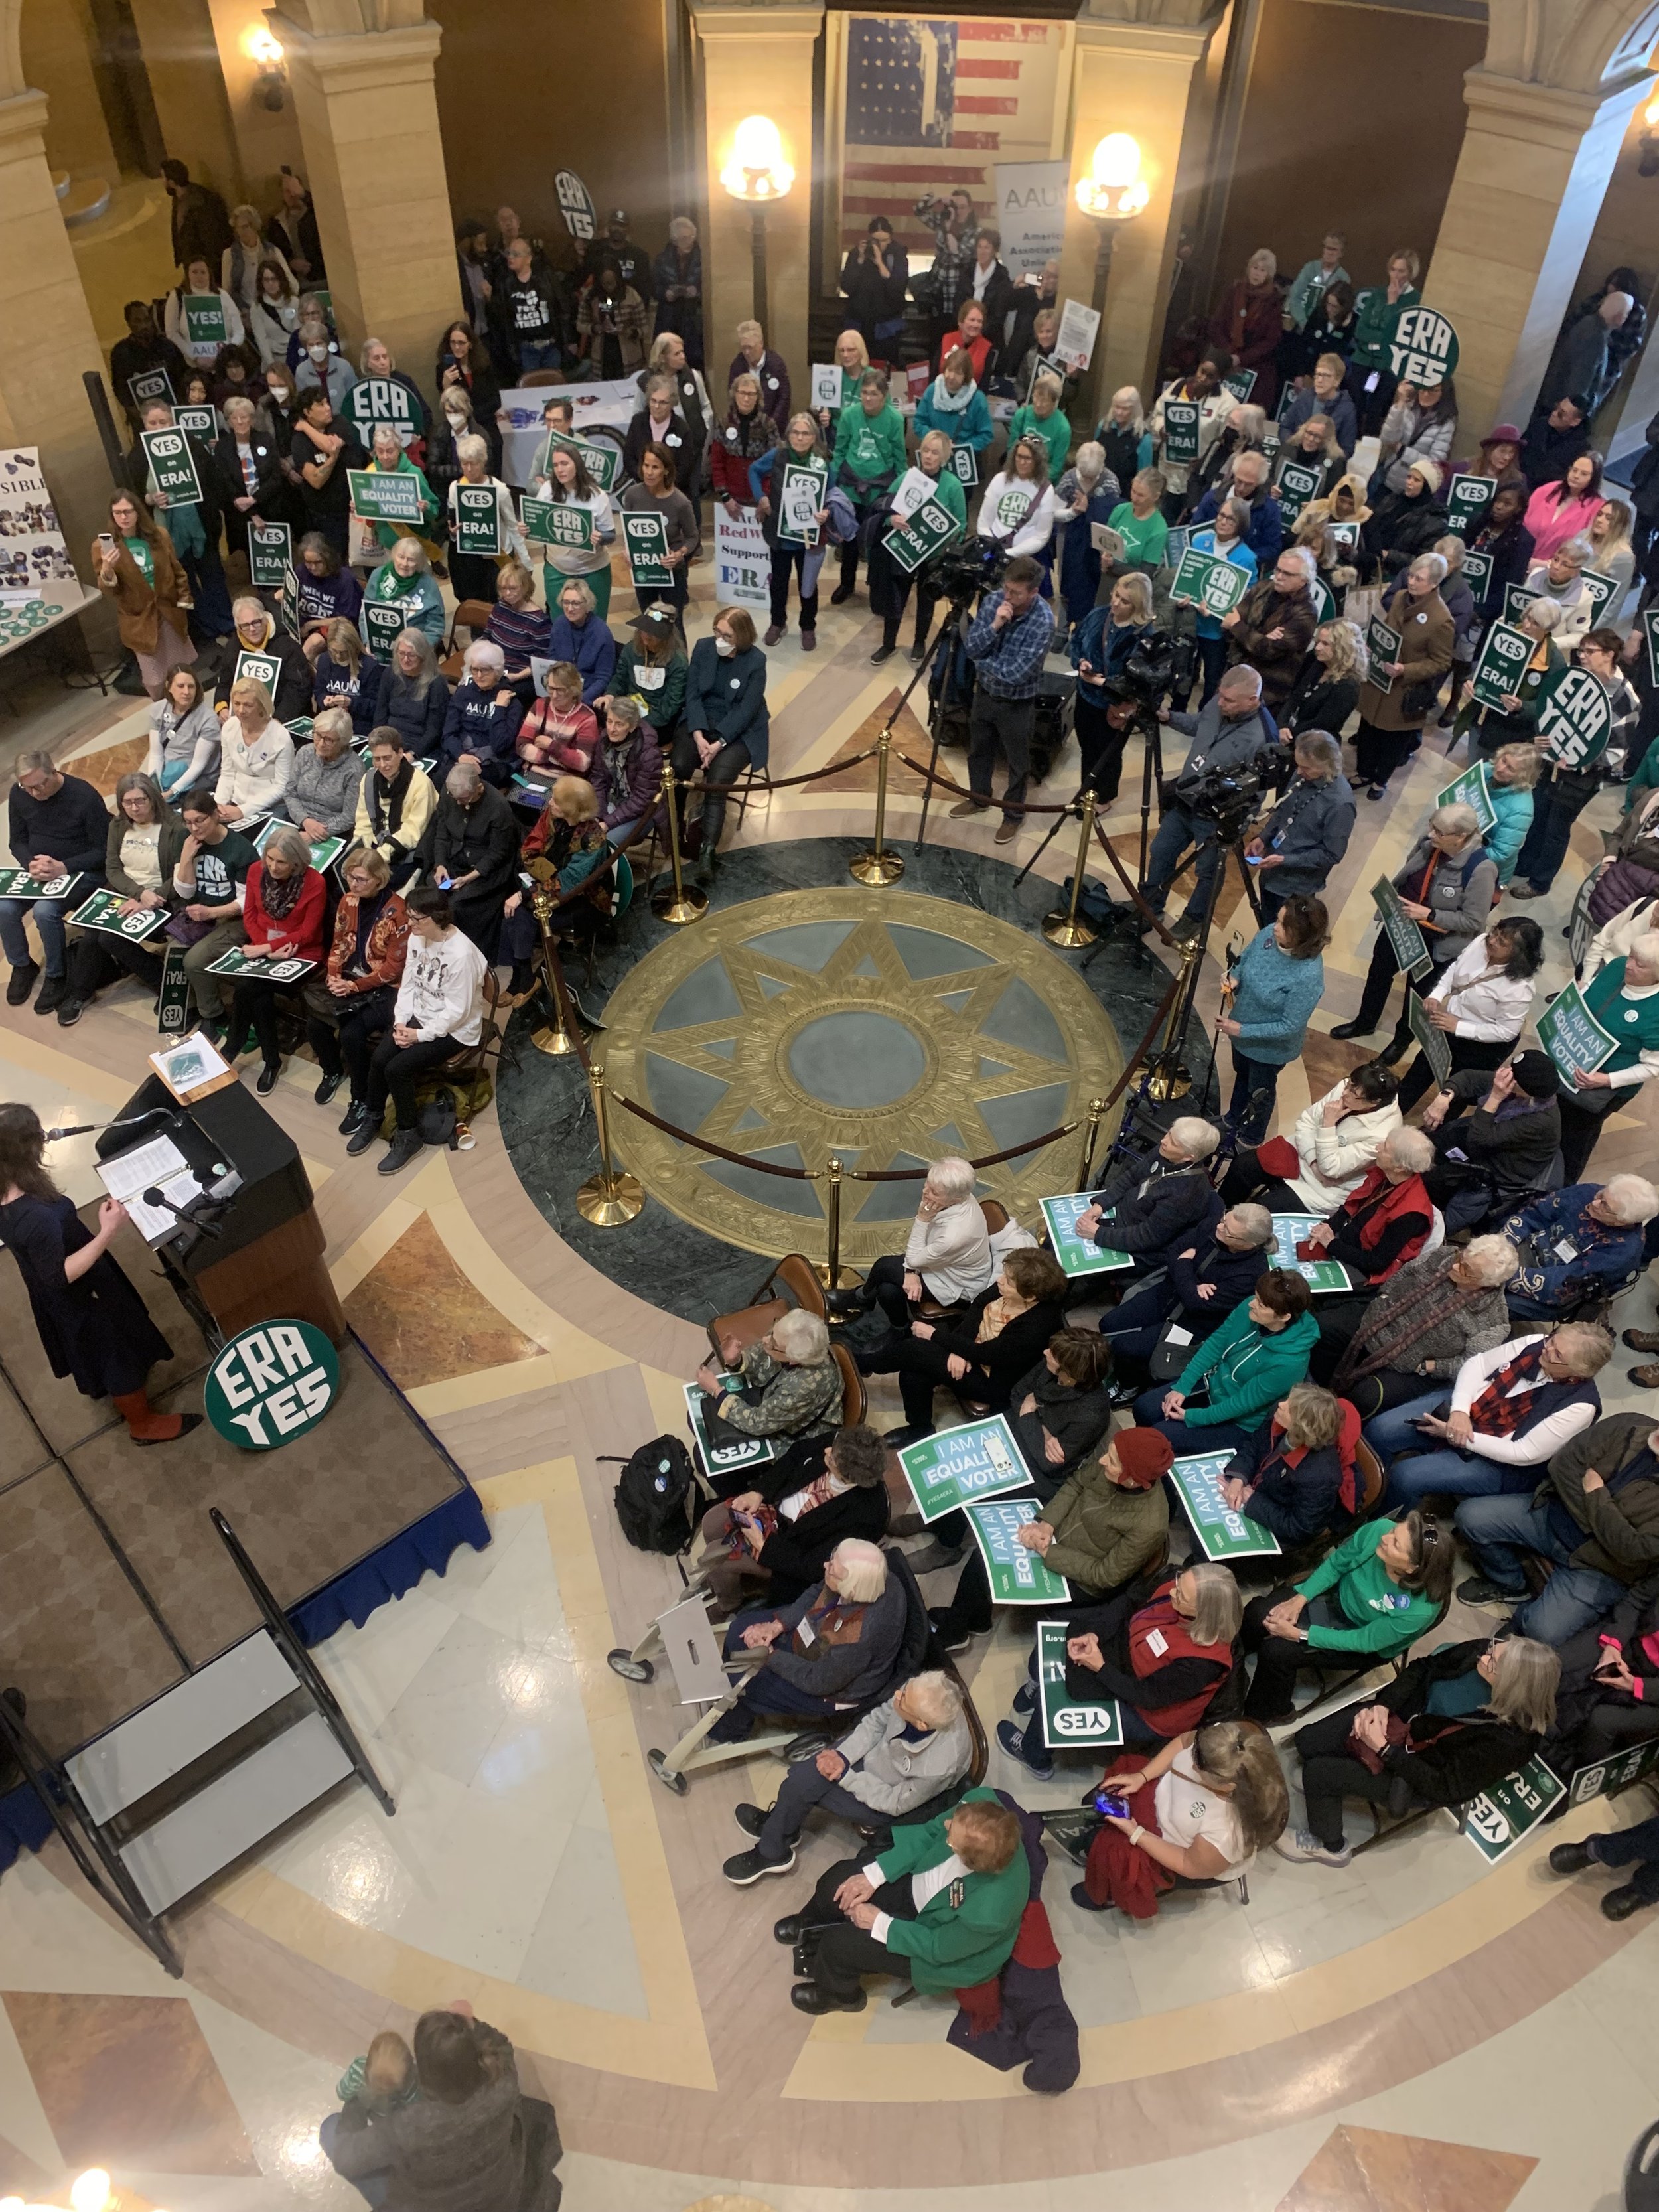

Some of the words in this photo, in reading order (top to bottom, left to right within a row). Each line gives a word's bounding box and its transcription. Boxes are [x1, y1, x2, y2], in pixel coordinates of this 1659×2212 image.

[555, 171, 587, 210] ERA
[1005, 188, 1062, 209] AAU
[561, 210, 593, 240] YES
[1010, 246, 1062, 255] Associati
[188, 311, 222, 325] YES!
[1395, 309, 1453, 358] ERA
[1389, 344, 1447, 387] YES
[139, 380, 162, 395] YES
[353, 381, 409, 418] ERA
[182, 416, 207, 427] YES
[1171, 410, 1193, 421] YES
[352, 421, 415, 449] YS
[1169, 437, 1196, 449] ERA!
[153, 439, 179, 453] YES
[957, 453, 968, 477] YES
[159, 469, 192, 487] ERA!
[372, 480, 376, 488] I
[379, 480, 396, 490] AM
[399, 481, 413, 491] AN
[794, 477, 817, 491] YES
[1289, 473, 1309, 490] YES
[361, 490, 415, 504] EQUALITY
[464, 494, 490, 504] YES
[1461, 486, 1484, 500] YES
[381, 503, 418, 516] VOTER
[1001, 493, 1030, 512] ERA
[552, 508, 581, 531] ERA
[926, 506, 945, 531] YES
[1448, 515, 1467, 528] ER
[258, 531, 282, 542] YES
[463, 522, 494, 535] ERA!
[551, 526, 583, 544] YES
[631, 523, 656, 534] YES
[719, 524, 747, 539] Red
[901, 527, 928, 553] ERA!
[255, 557, 287, 569] ERA!
[1208, 567, 1237, 594] ERA
[323, 594, 336, 604] WE
[1205, 585, 1231, 609] YES
[1514, 595, 1530, 608] YE
[372, 611, 397, 625] YES
[1375, 625, 1392, 648] YES
[1499, 636, 1522, 658] YES
[246, 664, 269, 679] YES
[1481, 666, 1514, 692] ERA!
[1553, 670, 1607, 741] ERA
[1538, 696, 1589, 766] YES
[6, 871, 31, 894] ERA!
[44, 876, 64, 892] YES
[92, 908, 115, 924] RA!
[125, 910, 149, 930] YES
[273, 962, 296, 976] YES
[165, 1008, 180, 1022] YES
[1553, 1009, 1595, 1065] EQUALITY
[1571, 1015, 1589, 1037] AM
[1585, 1035, 1605, 1055] AN
[1056, 1200, 1068, 1213] AN
[1058, 1217, 1074, 1235] AM
[1273, 1220, 1286, 1240] AN
[1277, 1248, 1289, 1264] AM
[214, 1327, 313, 1409] ERA
[230, 1366, 331, 1445] YES
[716, 1441, 756, 1459] YES
[937, 1445, 946, 1457] I
[950, 1436, 975, 1456] AM
[927, 1447, 1005, 1485] EQUALI
[1179, 1465, 1200, 1484] AN
[960, 1465, 1019, 1489] VOTER
[1191, 1488, 1214, 1512] AM
[979, 1508, 995, 1524] AN
[987, 1527, 1005, 1552] AM
[997, 1507, 1033, 1584] EQUALITY
[1059, 1712, 1106, 1730] YES
[1580, 1772, 1600, 1799] YES
[1498, 1789, 1511, 1805] on
[1468, 1794, 1503, 1840] YES
